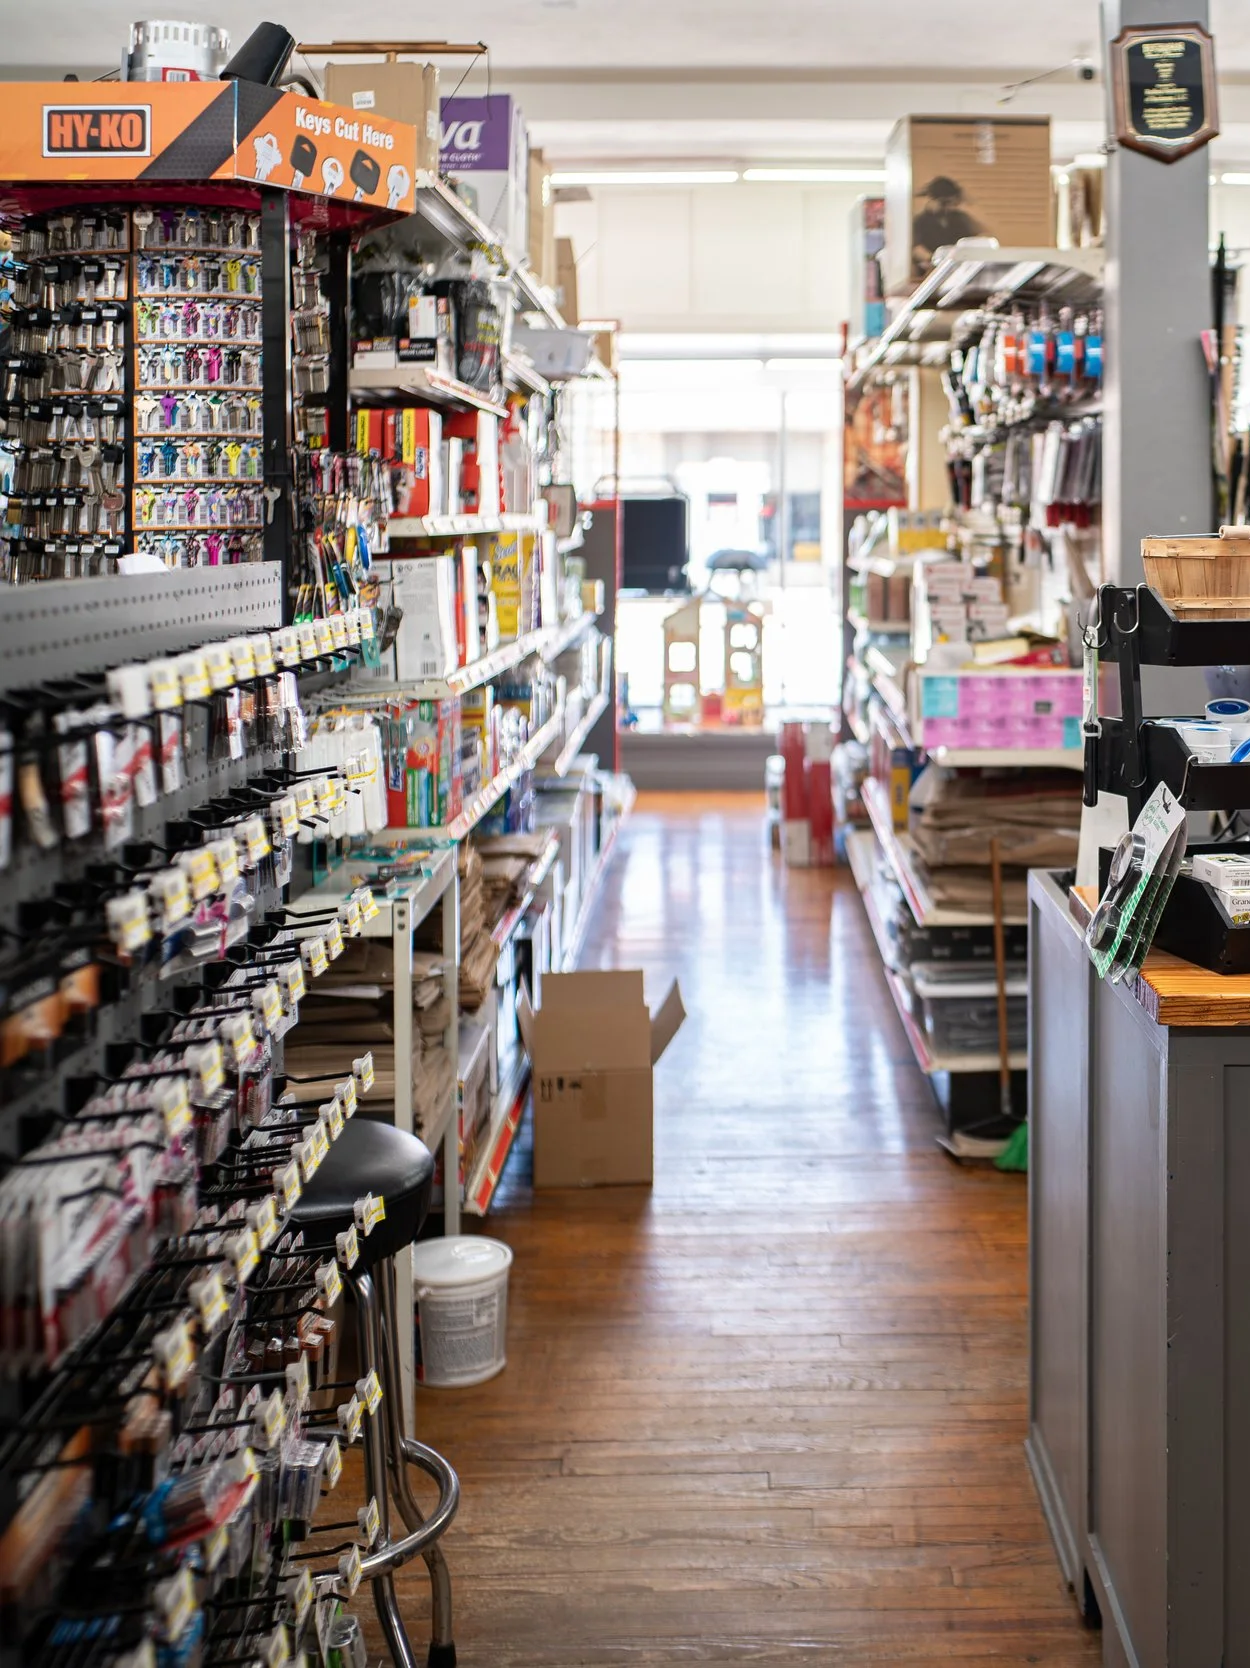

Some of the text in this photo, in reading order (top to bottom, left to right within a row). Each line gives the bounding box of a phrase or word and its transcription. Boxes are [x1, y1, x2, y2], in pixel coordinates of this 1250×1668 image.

[51, 113, 143, 148] HY-KO
[295, 106, 394, 150] Keys Cut Here
